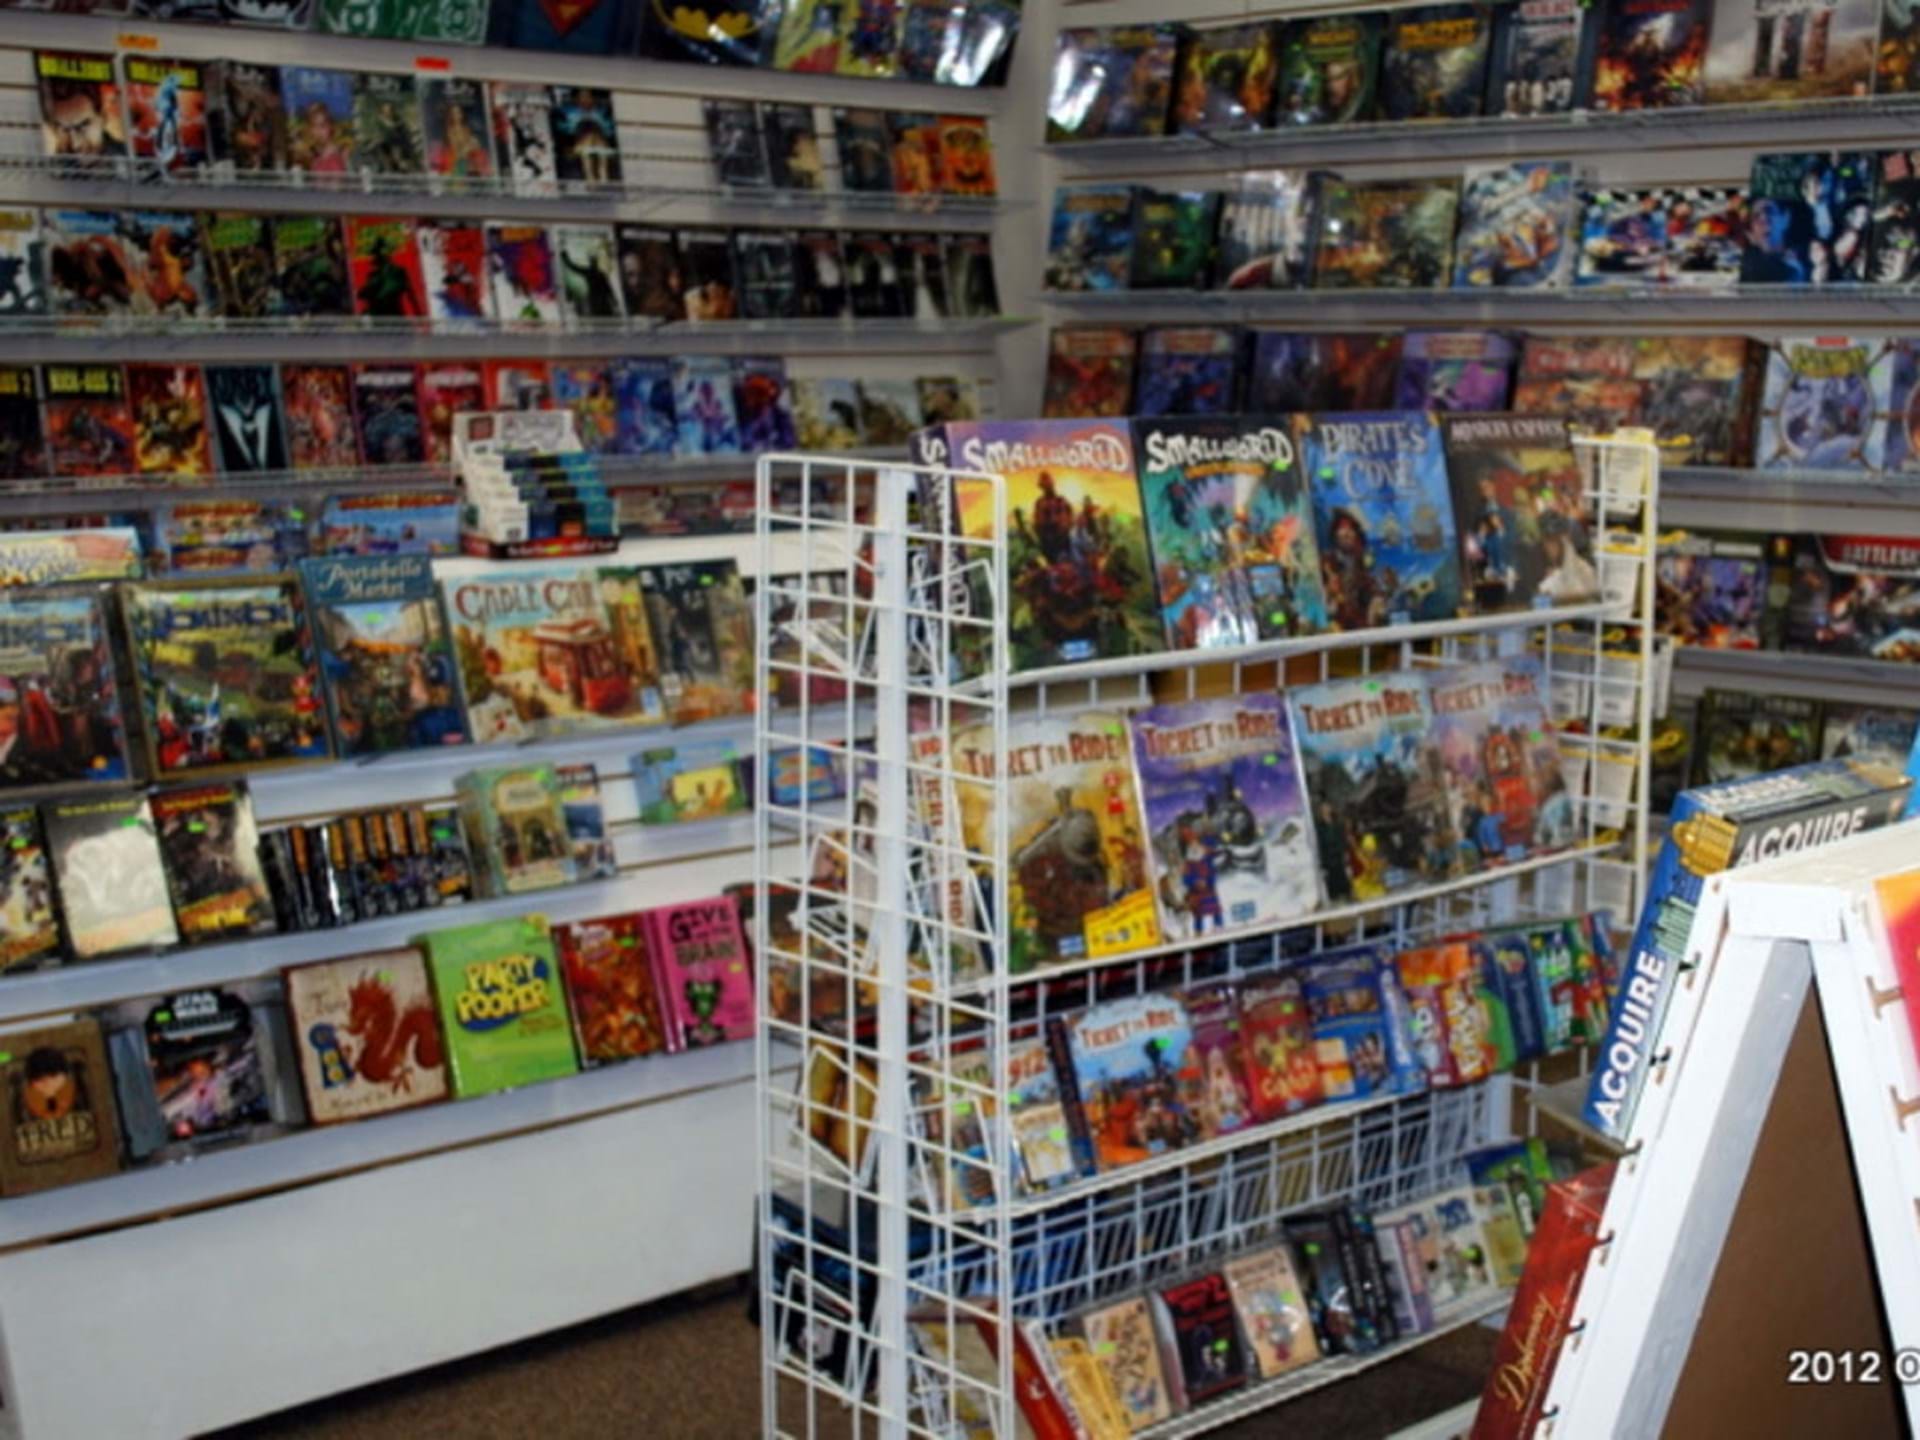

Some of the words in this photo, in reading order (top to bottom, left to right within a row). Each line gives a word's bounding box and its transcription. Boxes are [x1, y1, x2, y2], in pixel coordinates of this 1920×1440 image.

[465, 954, 537, 992] PARTY
[456, 978, 548, 1024] POOPER
[1593, 950, 1666, 1128] ACQUIRE
